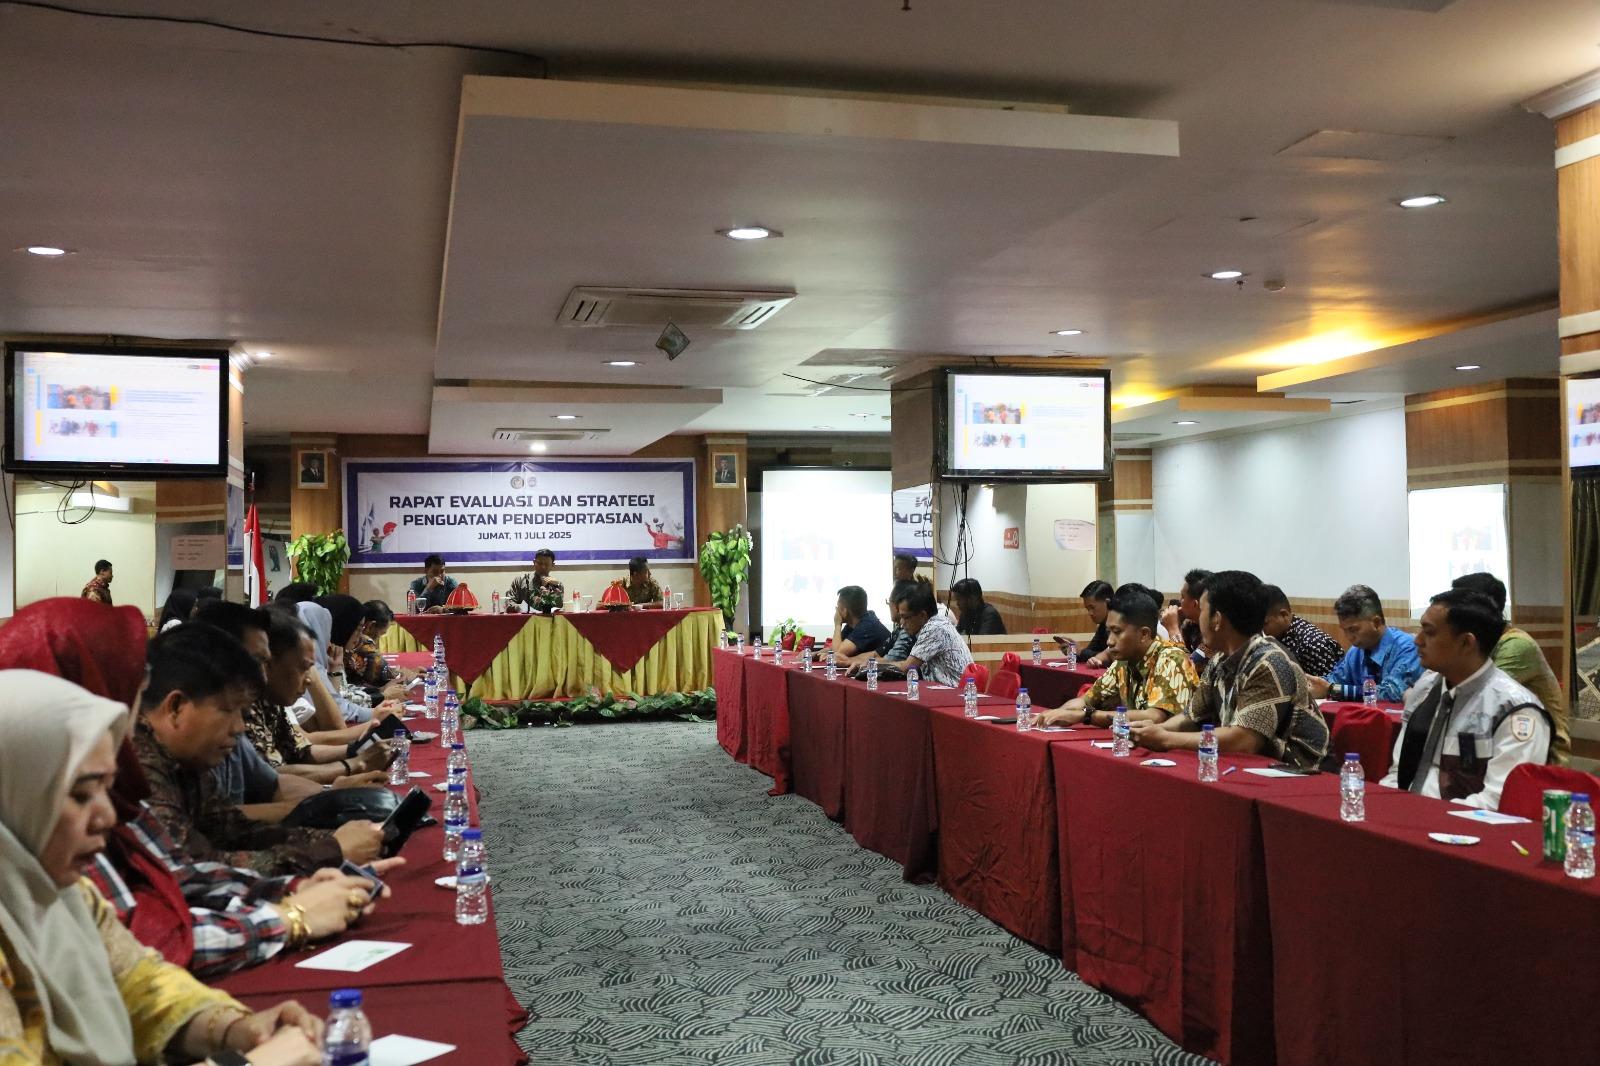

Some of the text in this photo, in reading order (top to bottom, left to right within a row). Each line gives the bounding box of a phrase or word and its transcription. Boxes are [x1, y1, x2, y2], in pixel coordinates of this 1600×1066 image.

[389, 494, 655, 509] RAPAT EVALUASI DAN STRATEGI
[402, 512, 643, 526] PENGUATAN PENDEPORTASIAN
[477, 531, 572, 541] JUMAT, 11 JULI 2025
